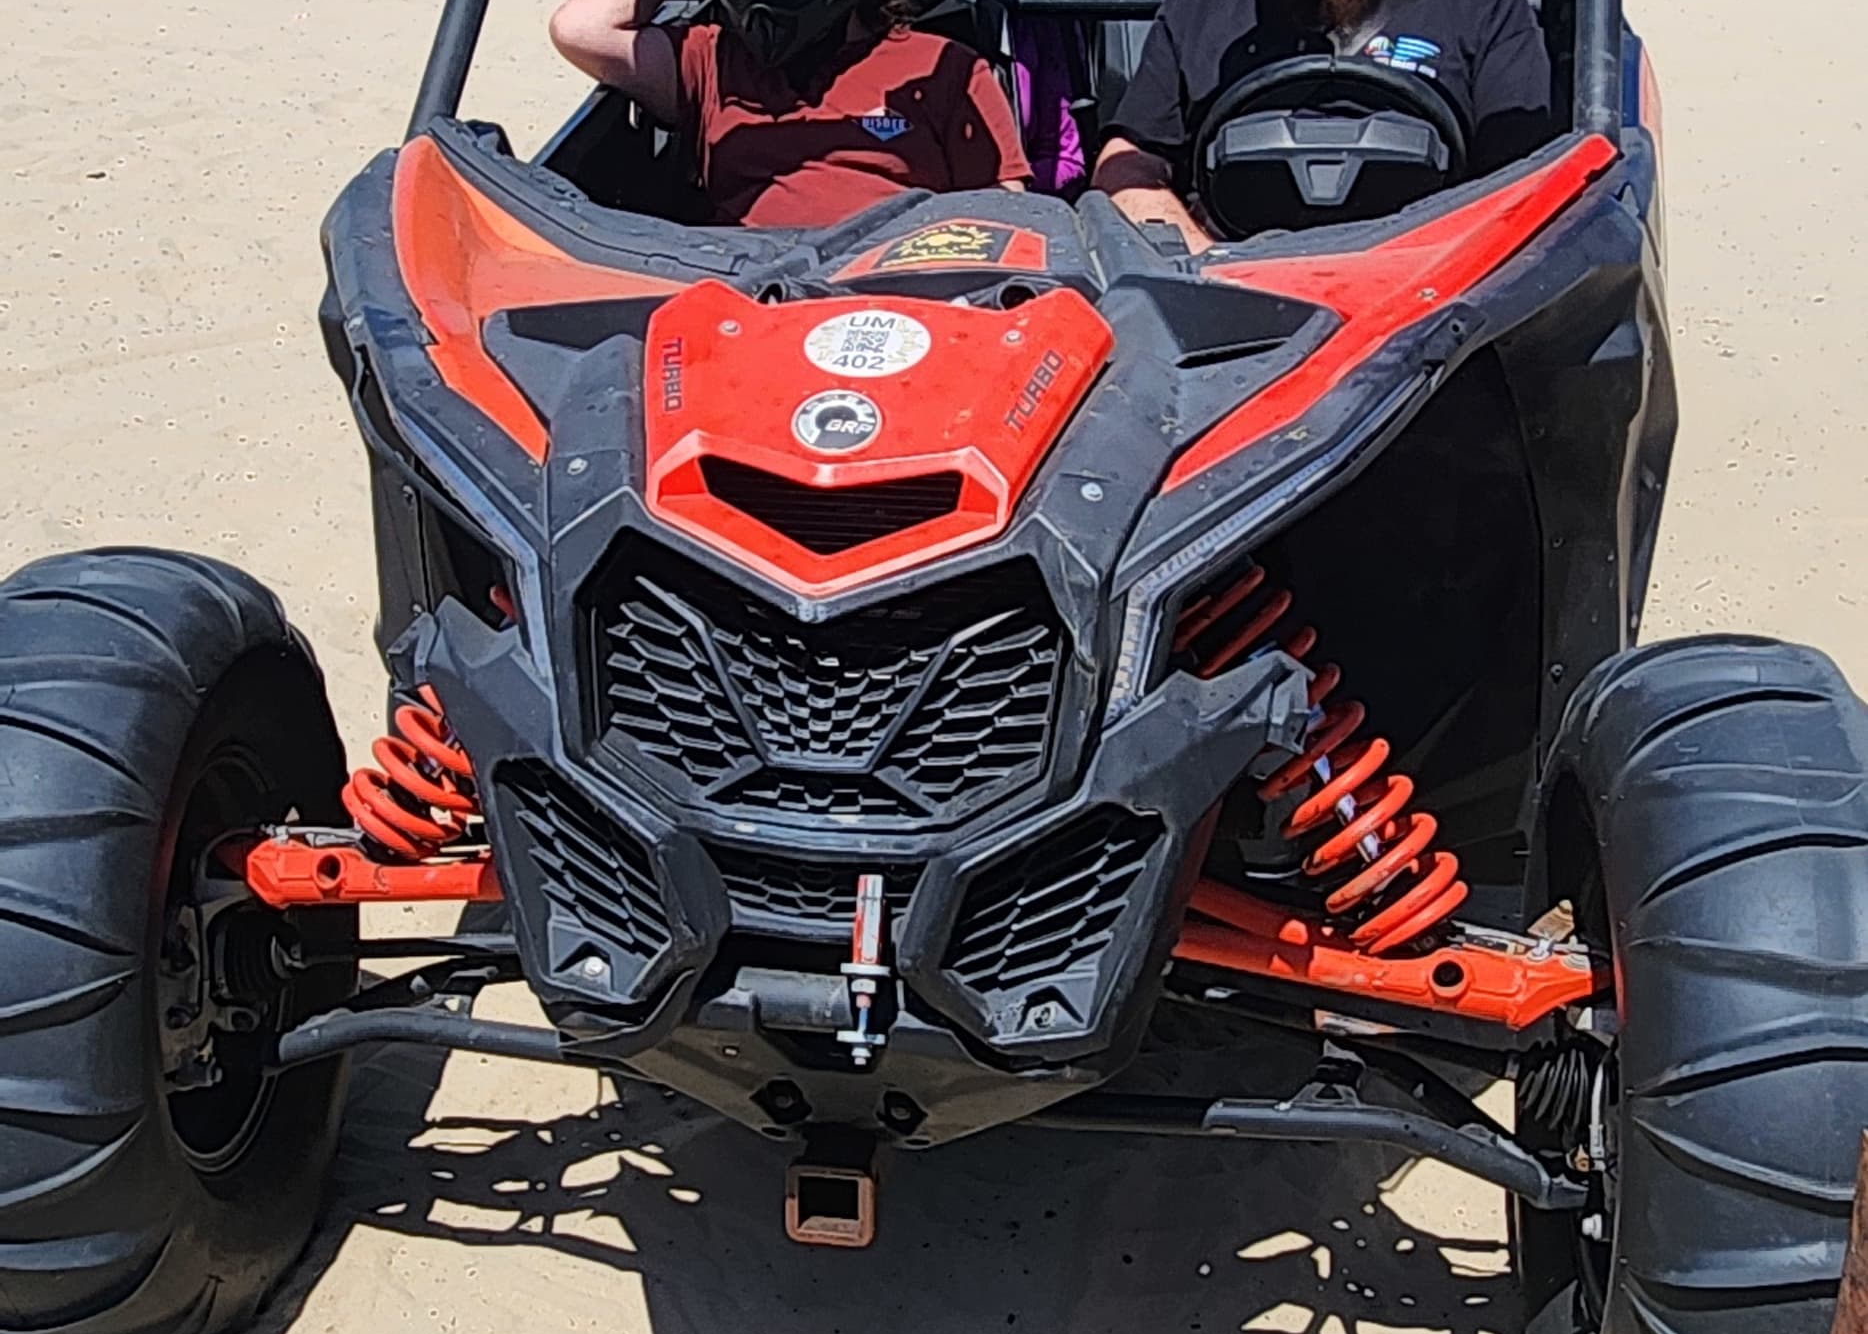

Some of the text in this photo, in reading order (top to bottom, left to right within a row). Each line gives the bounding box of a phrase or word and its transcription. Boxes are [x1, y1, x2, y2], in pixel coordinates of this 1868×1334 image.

[849, 316, 897, 329] UM
[661, 336, 682, 412] TURBO
[832, 354, 886, 371] 402
[1003, 349, 1064, 431] TURBO
